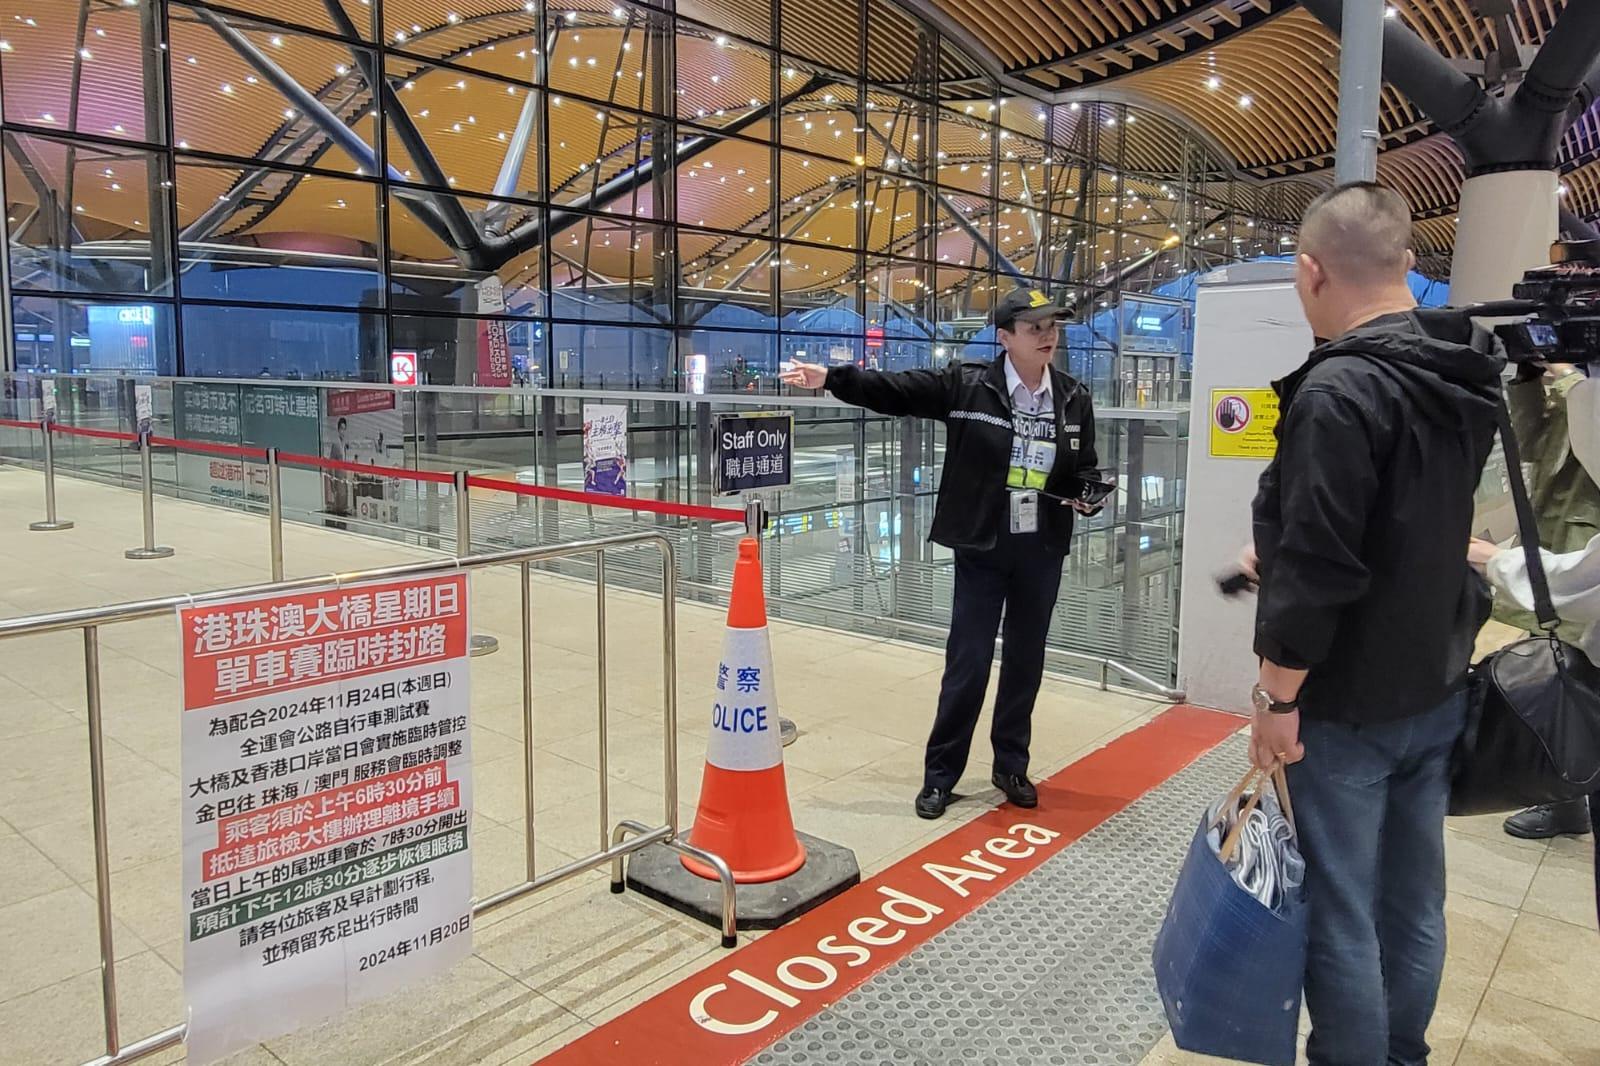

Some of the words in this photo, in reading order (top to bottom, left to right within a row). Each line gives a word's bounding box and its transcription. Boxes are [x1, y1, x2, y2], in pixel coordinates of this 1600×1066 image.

[397, 362, 409, 378] K
[722, 430, 755, 450] Staff
[757, 428, 787, 450] Only
[725, 453, 784, 480] 職員通道
[194, 583, 458, 653] 港珠澳大橋星期日
[215, 623, 446, 693] 單車賽臨時封路
[209, 672, 452, 736] 為配合2024年11月24日(本週日)
[240, 700, 430, 758] 全運會公路自行車測試賽
[712, 703, 768, 733] OLICE
[189, 715, 467, 798] 大橋及香港口岸當日會實施臨時管控
[195, 793, 256, 825] 金巴往
[261, 781, 299, 806] 珠海
[314, 768, 349, 792] 澳門
[354, 740, 462, 781] 服務會臨時調整
[209, 787, 455, 877] 抵達旅檢大樓辦理離境手續
[225, 766, 442, 844] 乘客須於上午6時30分前
[191, 836, 376, 909] 當日上午的尾班車會於
[382, 810, 467, 847] 7時30分開出
[195, 832, 463, 937] 預計下午12時30分逐步恢復服務
[262, 897, 419, 966] 並預留充足出行時間
[359, 914, 470, 971] 2024年11月20日
[689, 886, 944, 1035] Closed
[922, 823, 1061, 898] Area
